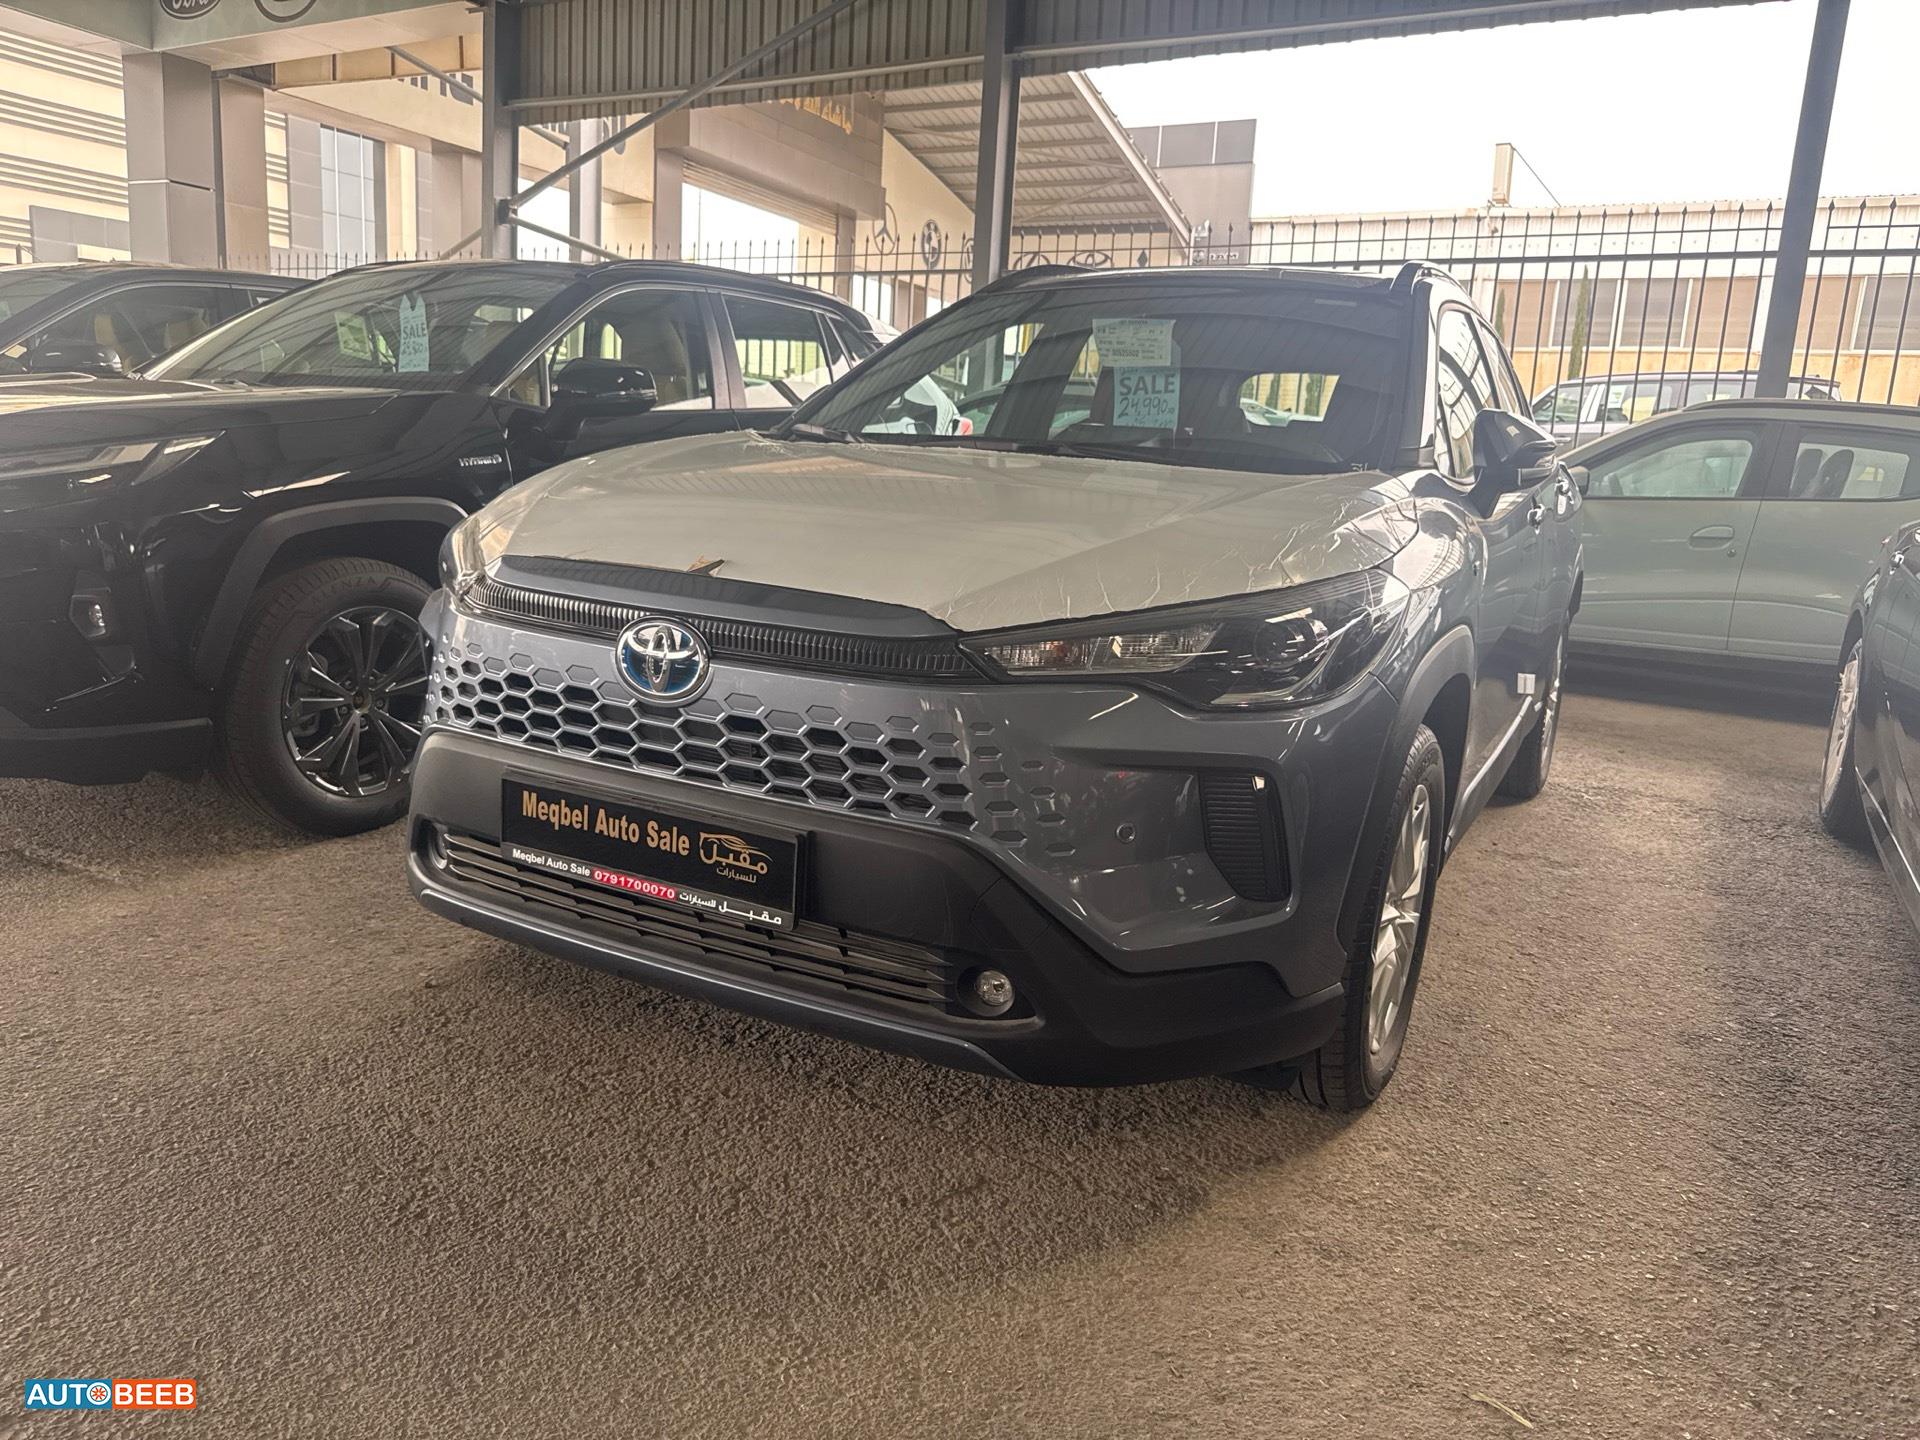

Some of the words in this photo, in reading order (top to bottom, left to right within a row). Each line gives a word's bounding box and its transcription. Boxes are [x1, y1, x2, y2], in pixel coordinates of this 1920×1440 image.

[402, 322, 427, 340] SALE
[1119, 372, 1176, 396] SALE
[522, 790, 589, 831] Meqbel
[595, 808, 640, 843] Auto
[646, 820, 690, 856] Sale
[512, 848, 545, 865] Meqbel
[546, 857, 568, 871] Auto
[570, 863, 591, 877] Sale
[594, 870, 676, 899] 0791700070
[716, 866, 757, 884] للسيارات
[679, 891, 716, 908] للسيارات
